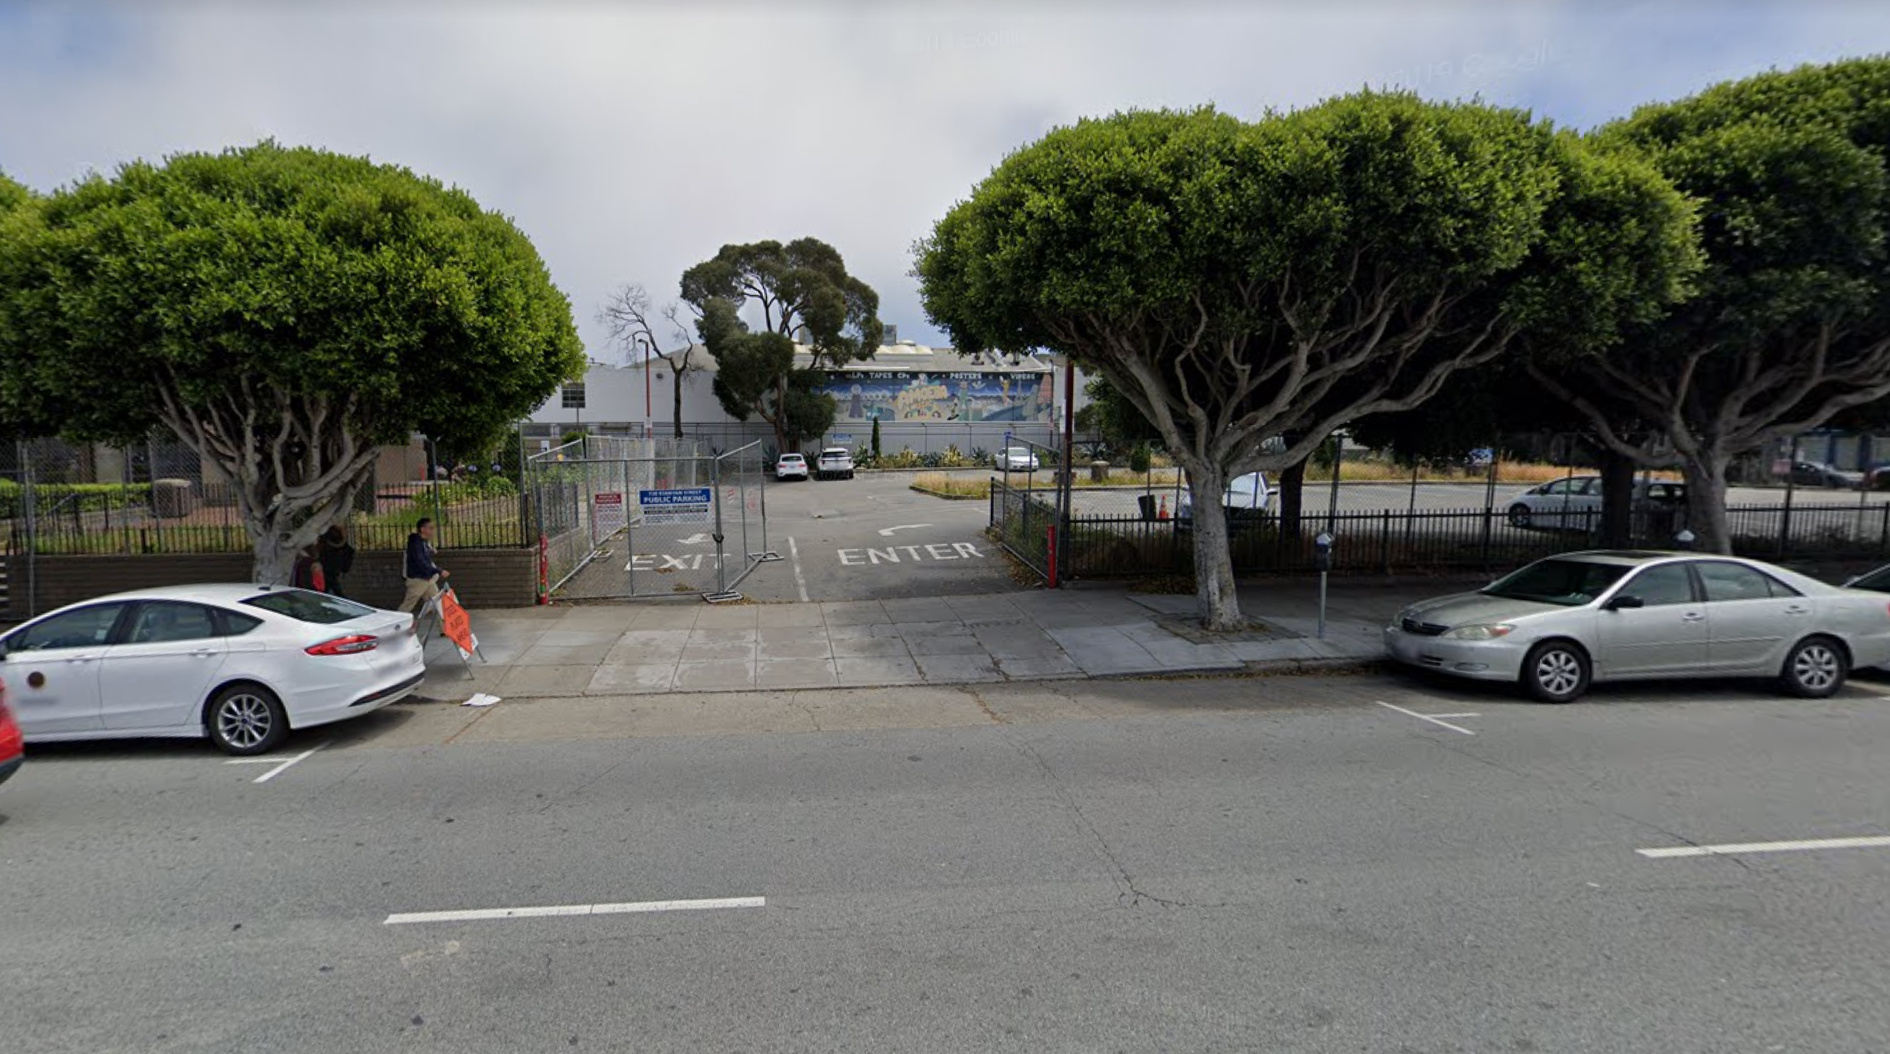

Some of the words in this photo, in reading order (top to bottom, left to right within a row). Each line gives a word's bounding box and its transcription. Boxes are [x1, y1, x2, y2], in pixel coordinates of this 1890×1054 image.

[949, 372, 982, 380] POSTERS
[1010, 372, 1037, 380] VIDEOS
[643, 496, 672, 504] PUBLIC
[673, 494, 708, 503] PARKING
[837, 542, 984, 565] ENTER
[624, 553, 731, 571] EXIT
